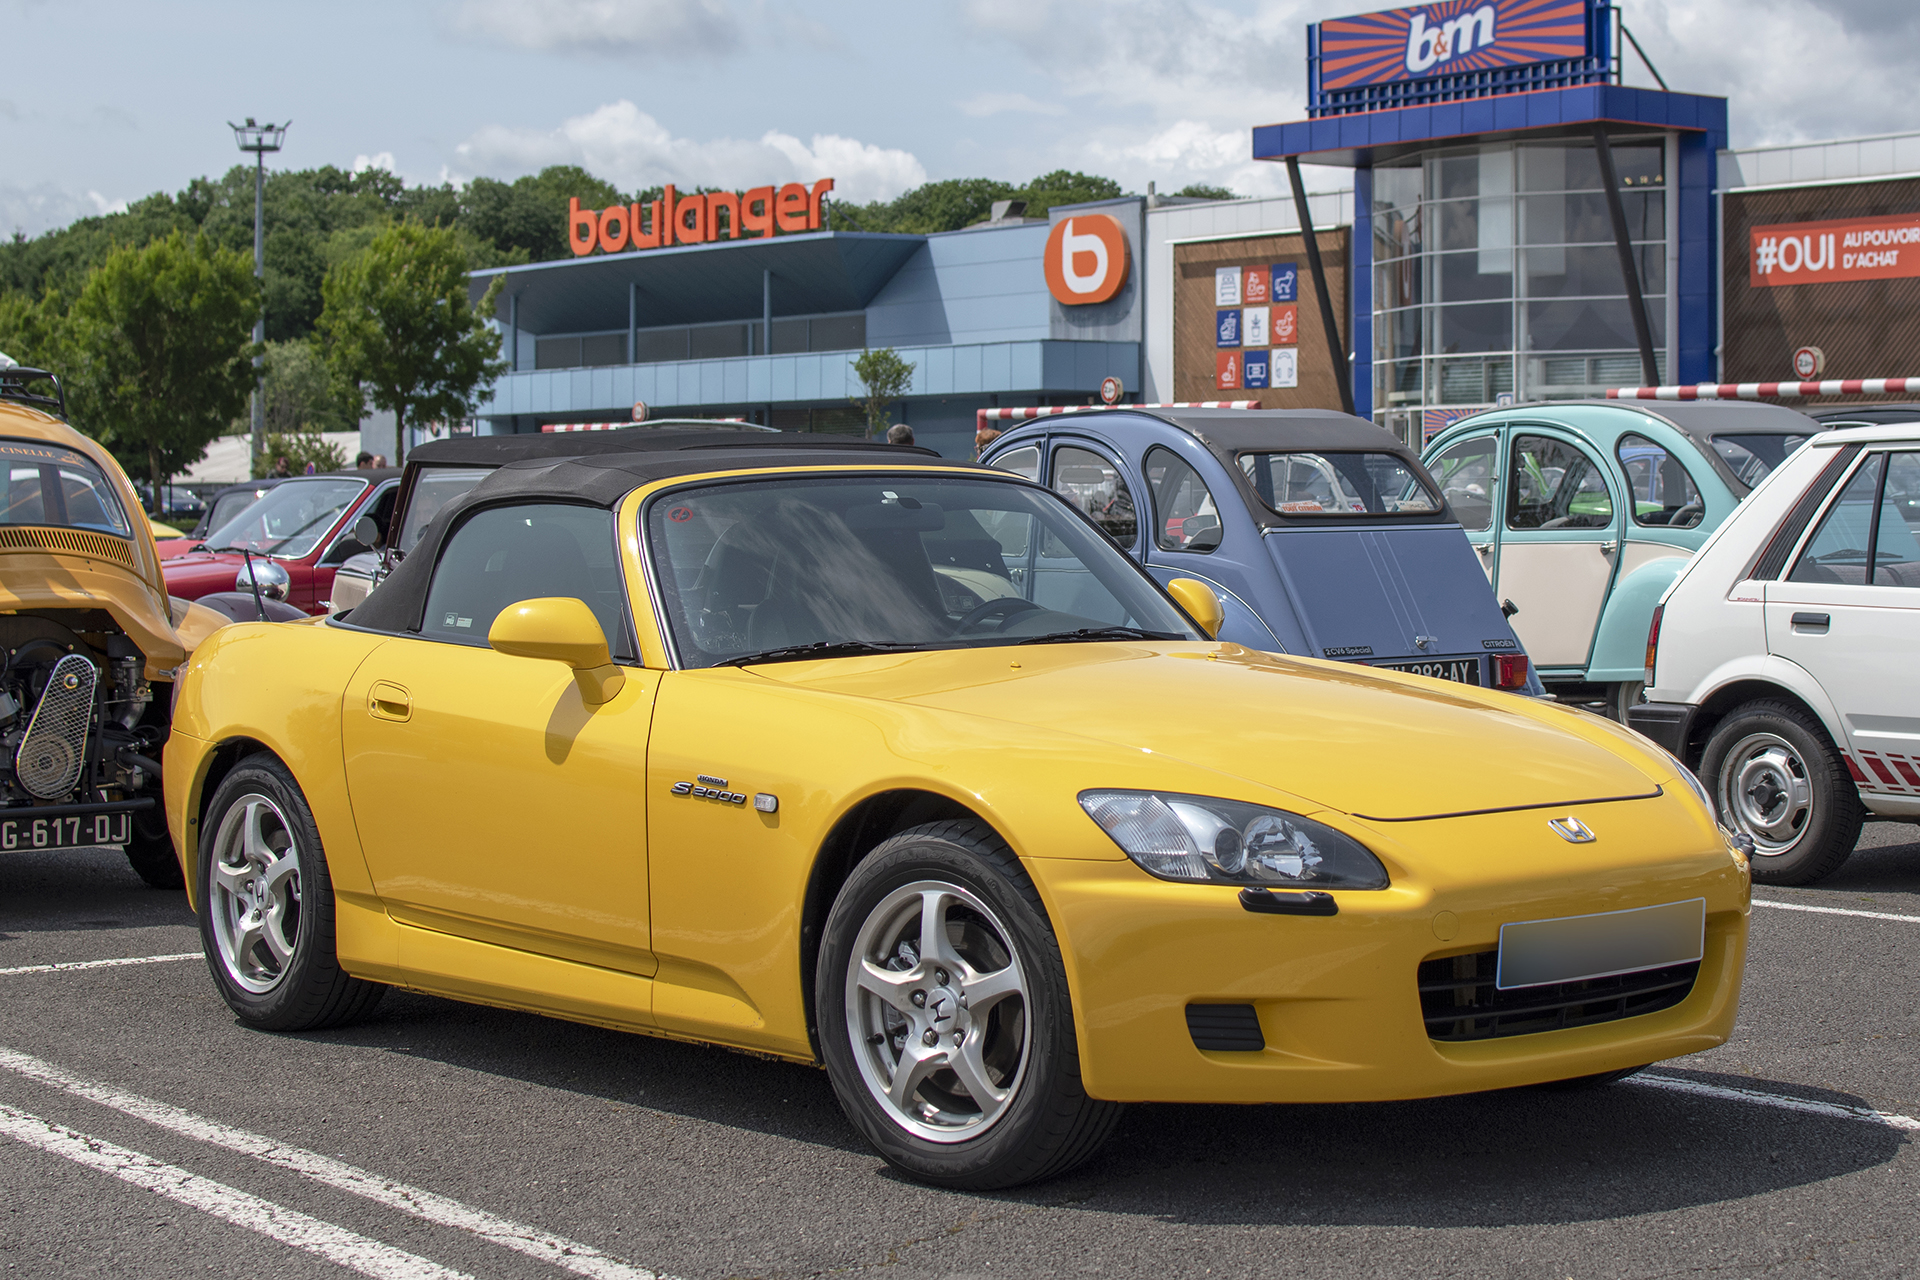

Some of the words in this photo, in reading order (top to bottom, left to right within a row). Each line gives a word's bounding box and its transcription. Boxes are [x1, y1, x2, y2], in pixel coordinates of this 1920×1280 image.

[1406, 5, 1495, 72] b&m
[570, 178, 834, 256] boulanger
[1843, 232, 1861, 248] AU
[1863, 227, 1920, 247] POUVOIR
[1062, 218, 1108, 294] b
[1756, 233, 1835, 275] #OUI
[1843, 250, 1899, 269] D'ACHAT
[0, 446, 55, 459] CINELLE
[699, 774, 725, 786] HONDA
